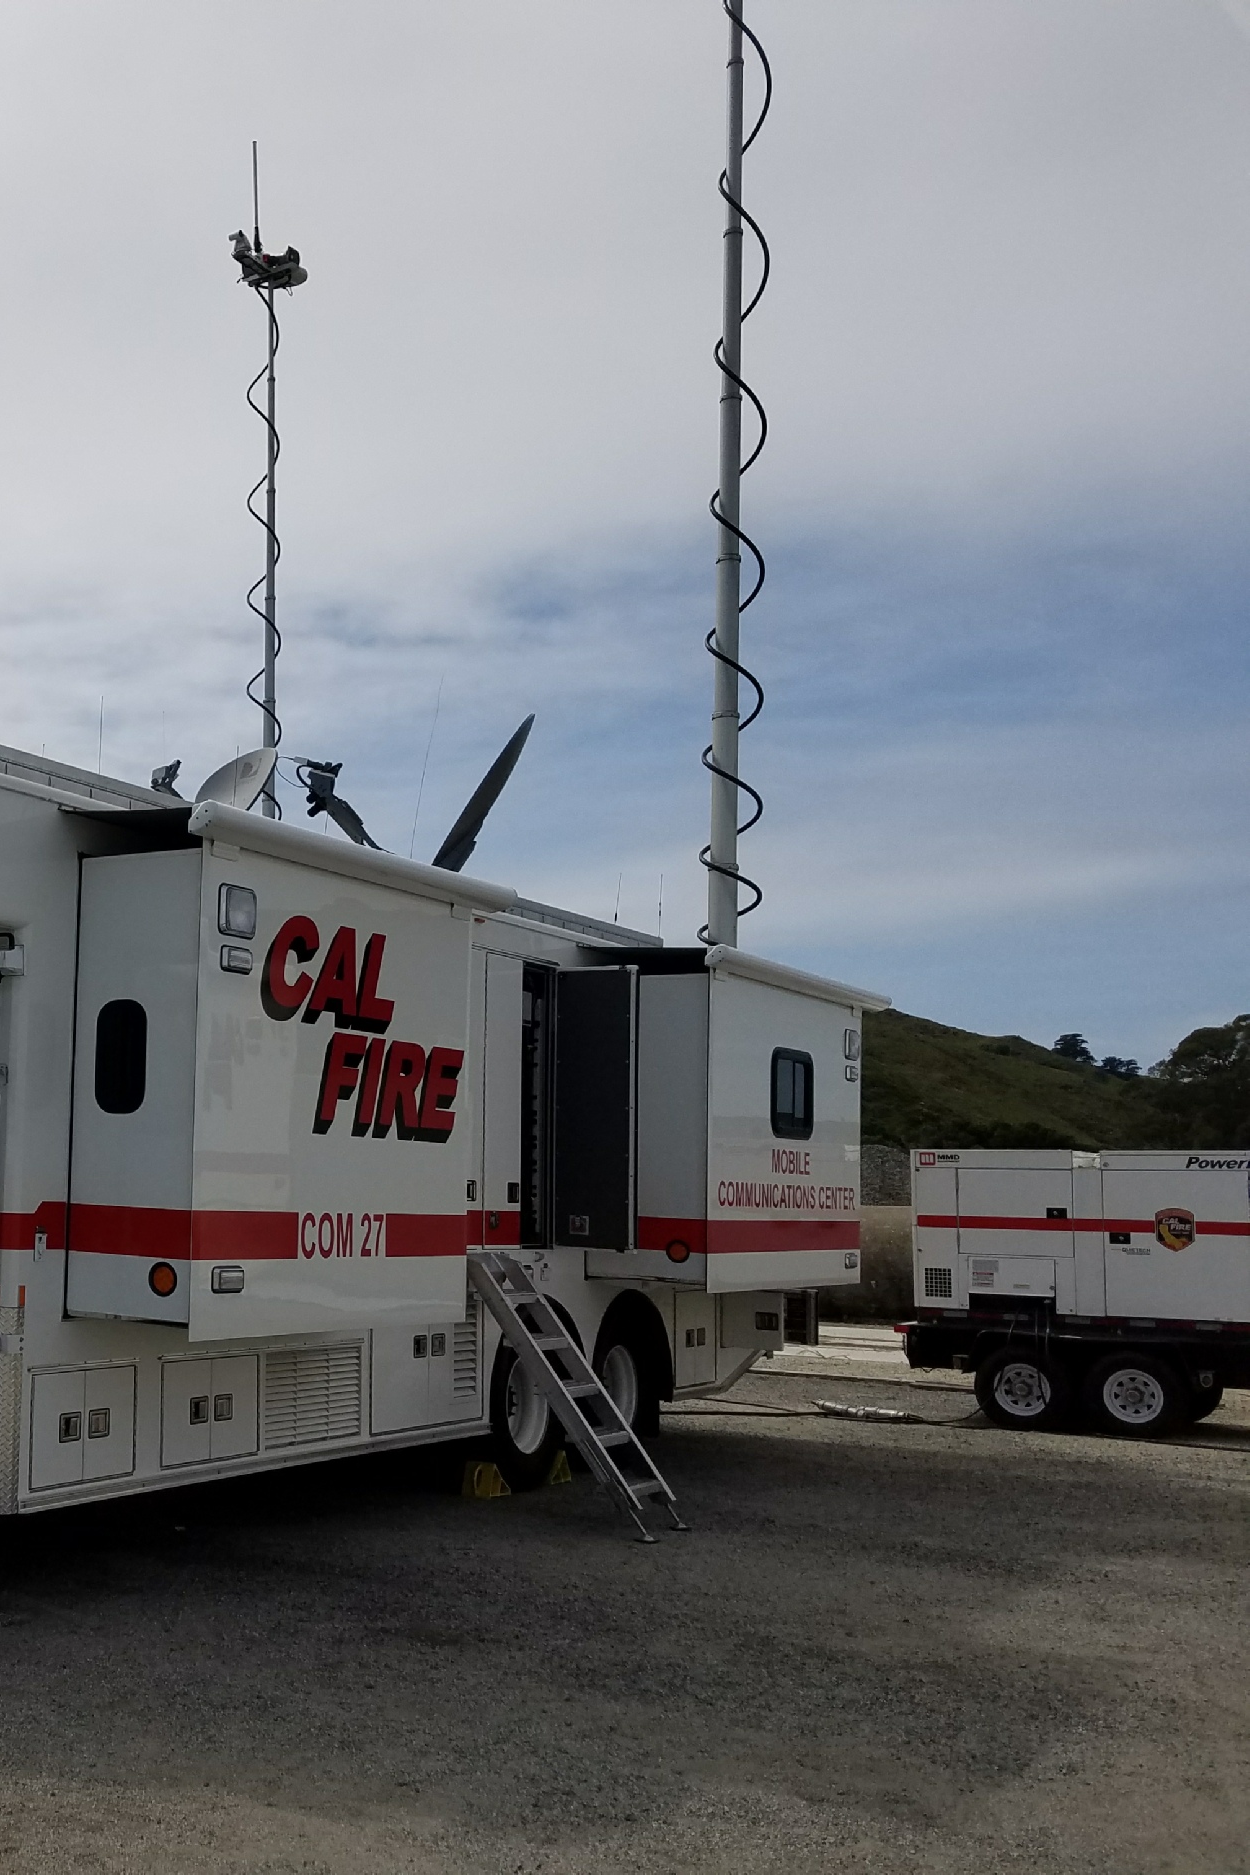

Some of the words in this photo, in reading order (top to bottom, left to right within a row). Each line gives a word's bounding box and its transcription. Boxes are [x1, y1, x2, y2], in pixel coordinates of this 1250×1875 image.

[260, 915, 395, 1034] CAL
[312, 1031, 465, 1144] FIRE
[771, 1148, 811, 1176] MOBILE
[1185, 1156, 1250, 1169] Power
[717, 1180, 816, 1209] COMMUNICATIONS
[818, 1186, 856, 1211] CENTER
[300, 1212, 353, 1259] COM
[360, 1214, 385, 1258] 27
[1162, 1217, 1179, 1225] CAL
[1170, 1223, 1192, 1231] FIRE
